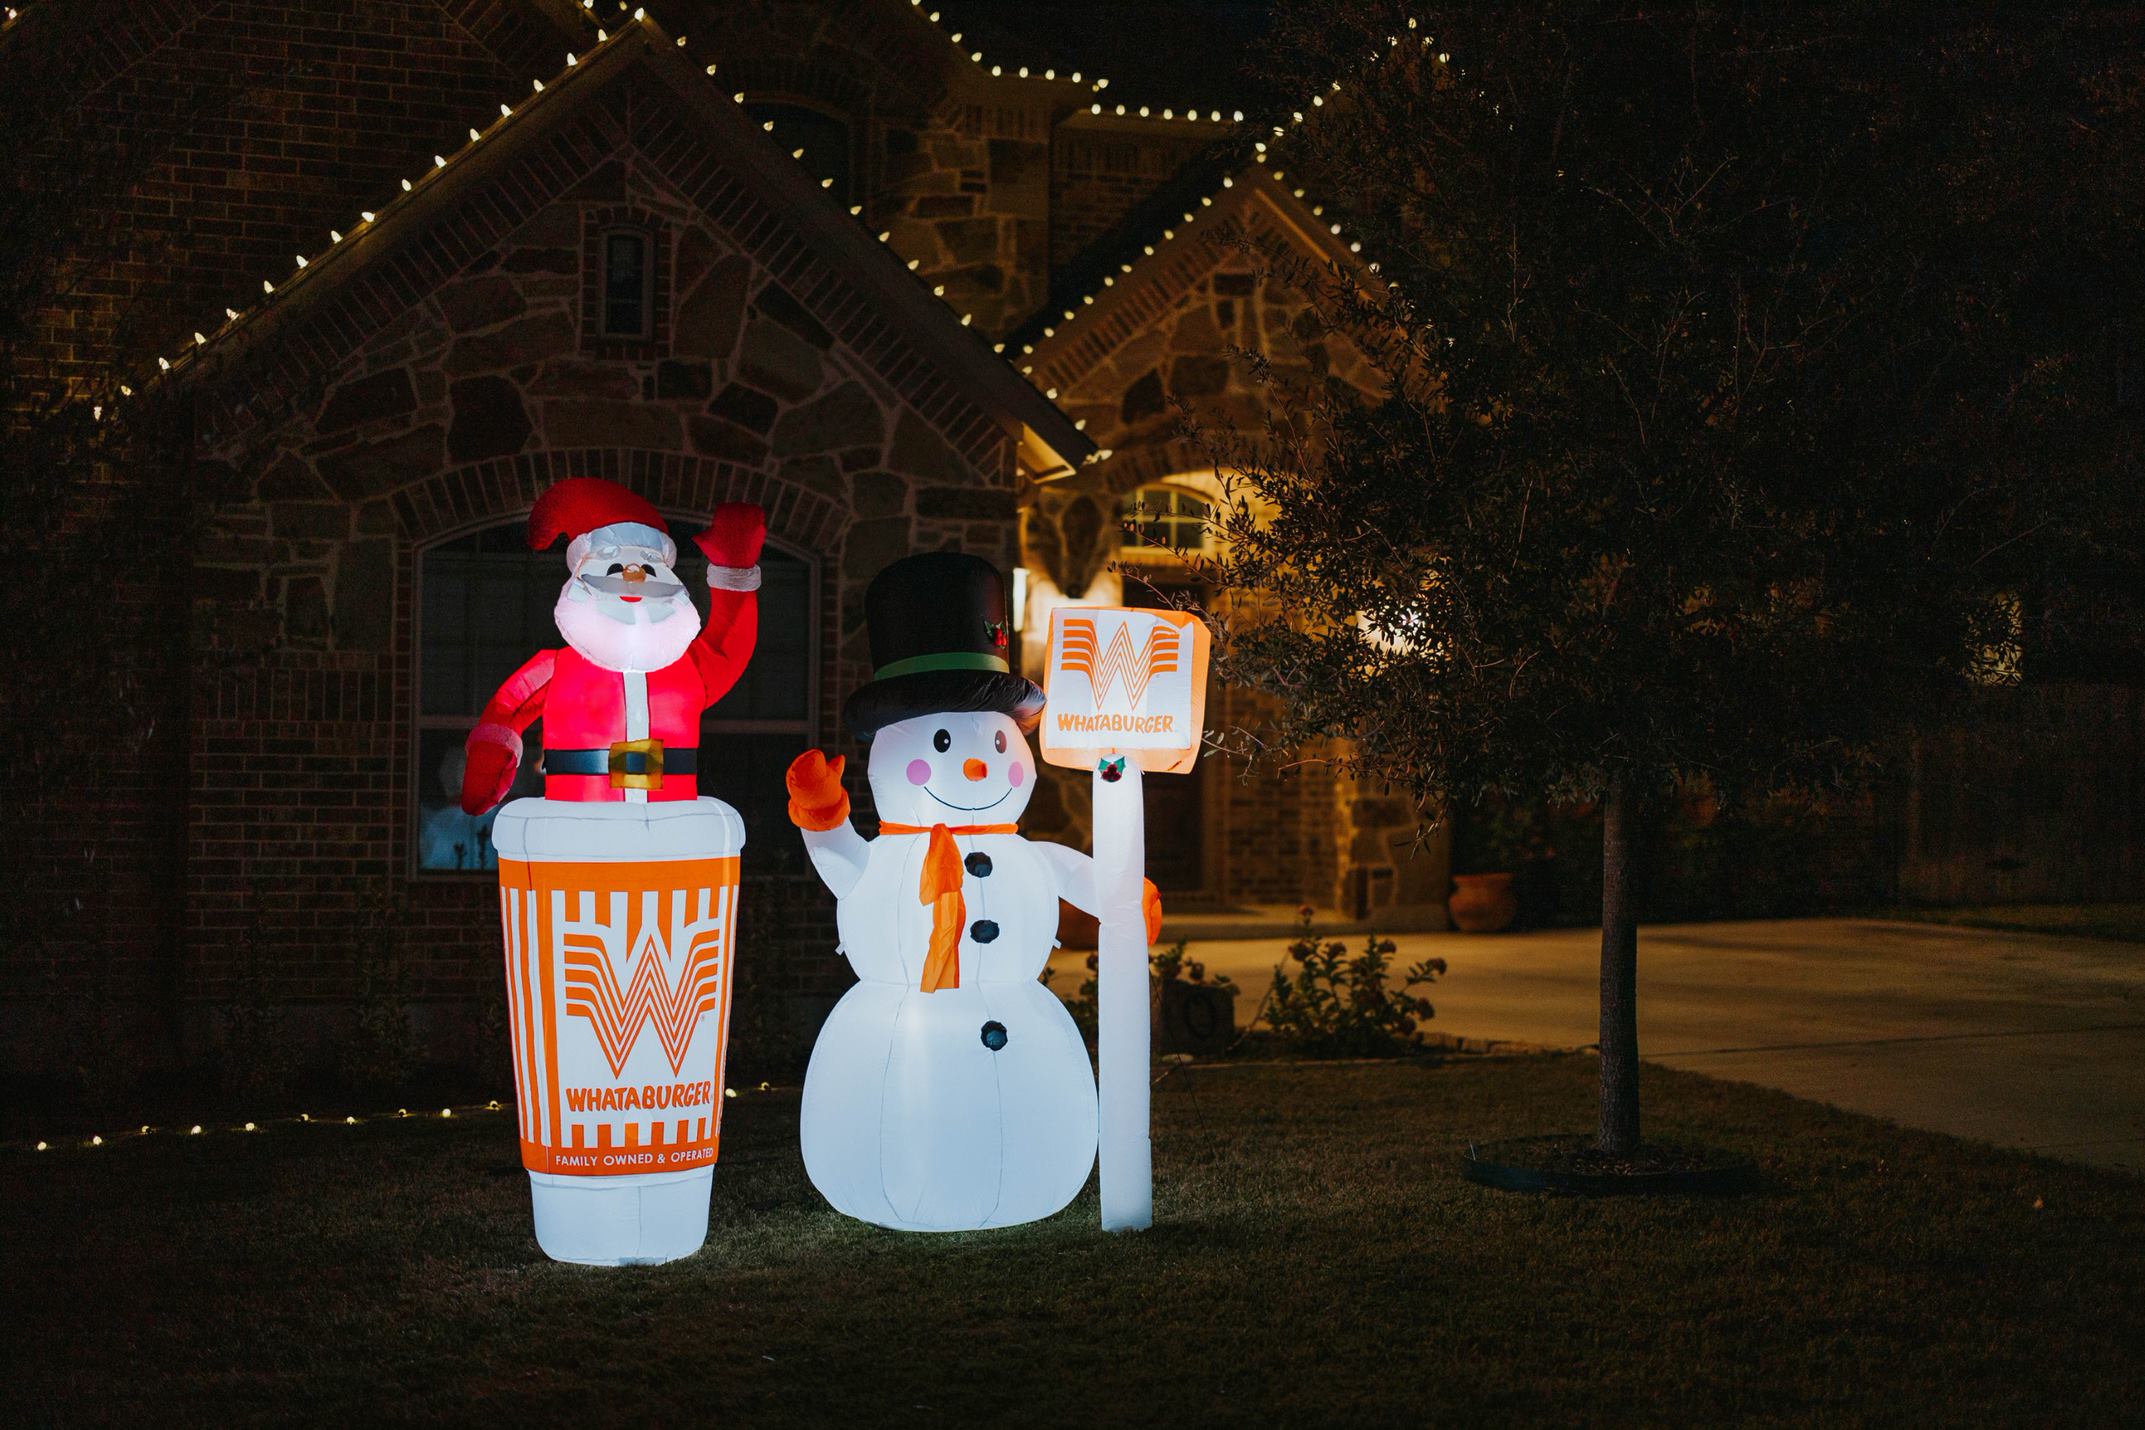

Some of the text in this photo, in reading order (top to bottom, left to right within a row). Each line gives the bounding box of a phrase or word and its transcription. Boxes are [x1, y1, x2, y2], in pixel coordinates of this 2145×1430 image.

[1057, 711, 1174, 734] WHATABURGER
[565, 1080, 712, 1112] WHATABURGER
[555, 1147, 714, 1167] FAMILY OWNED & OPERATED
